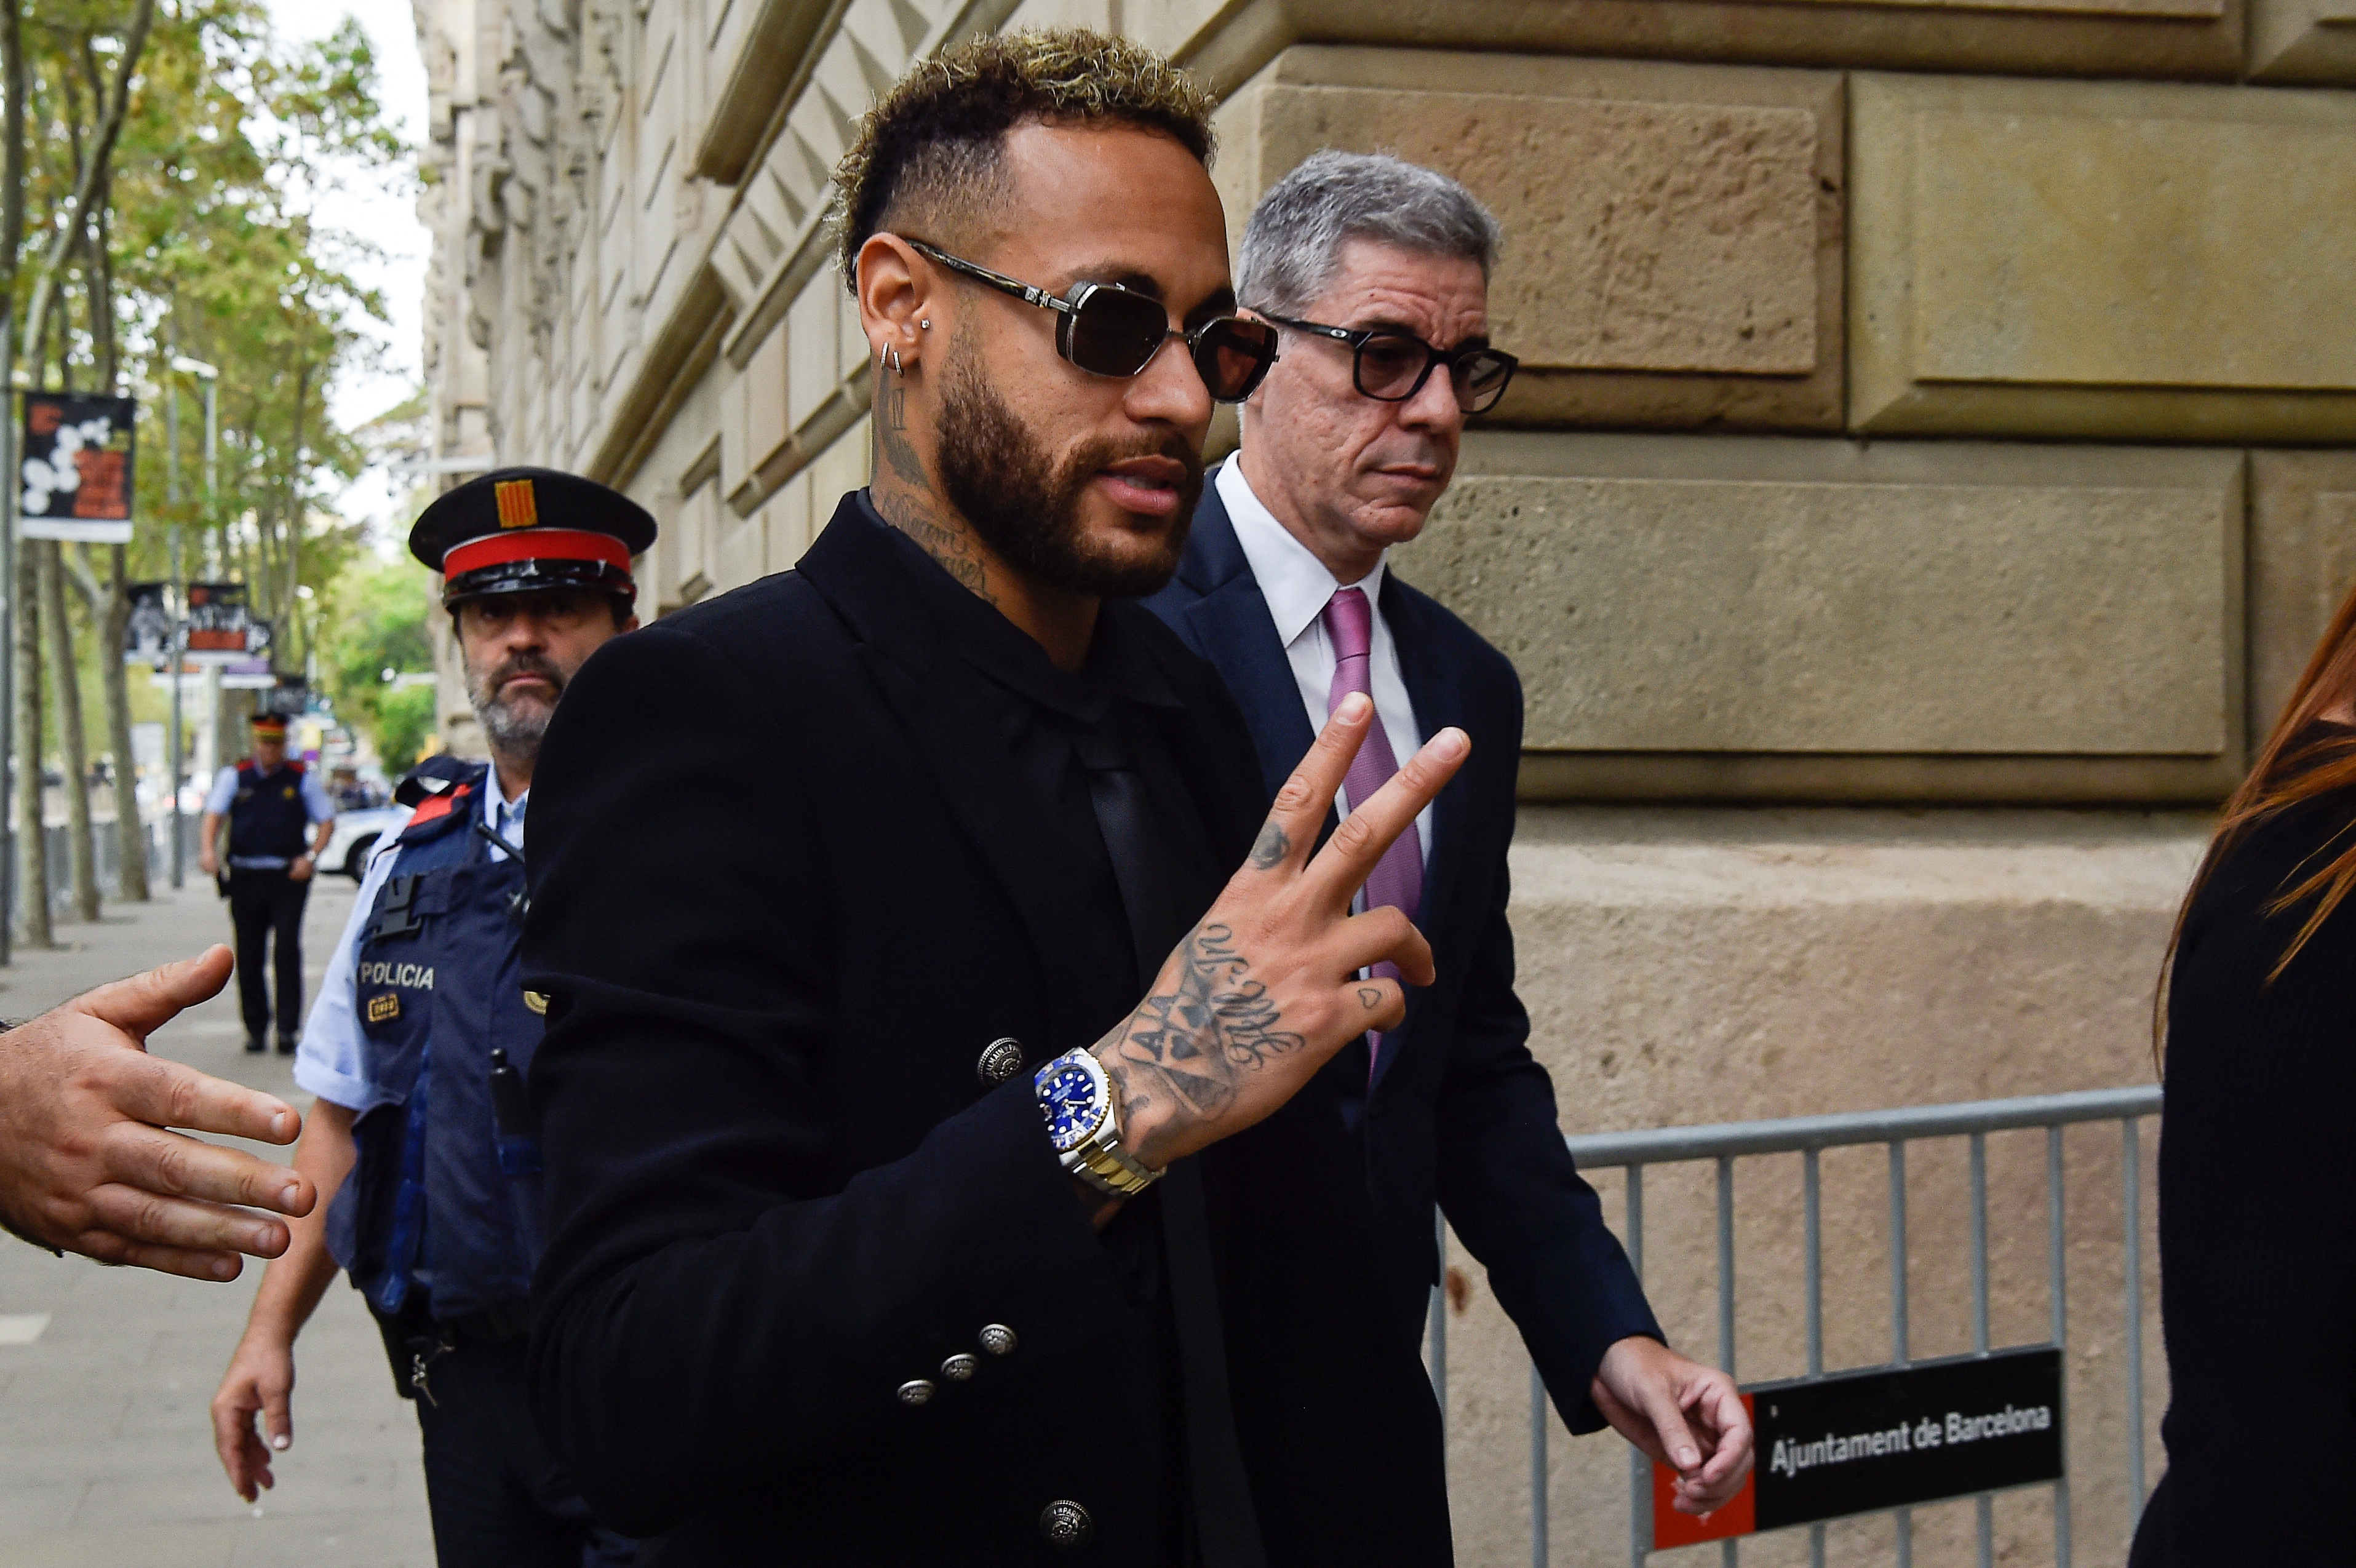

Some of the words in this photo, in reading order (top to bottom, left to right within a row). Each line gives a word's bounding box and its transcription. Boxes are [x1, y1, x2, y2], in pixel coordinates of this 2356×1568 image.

[360, 961, 434, 990] POLICIA
[1770, 1420, 1911, 1478] Ajuntament
[1913, 1417, 1942, 1449] de
[1944, 1404, 2052, 1444] Barcelona
